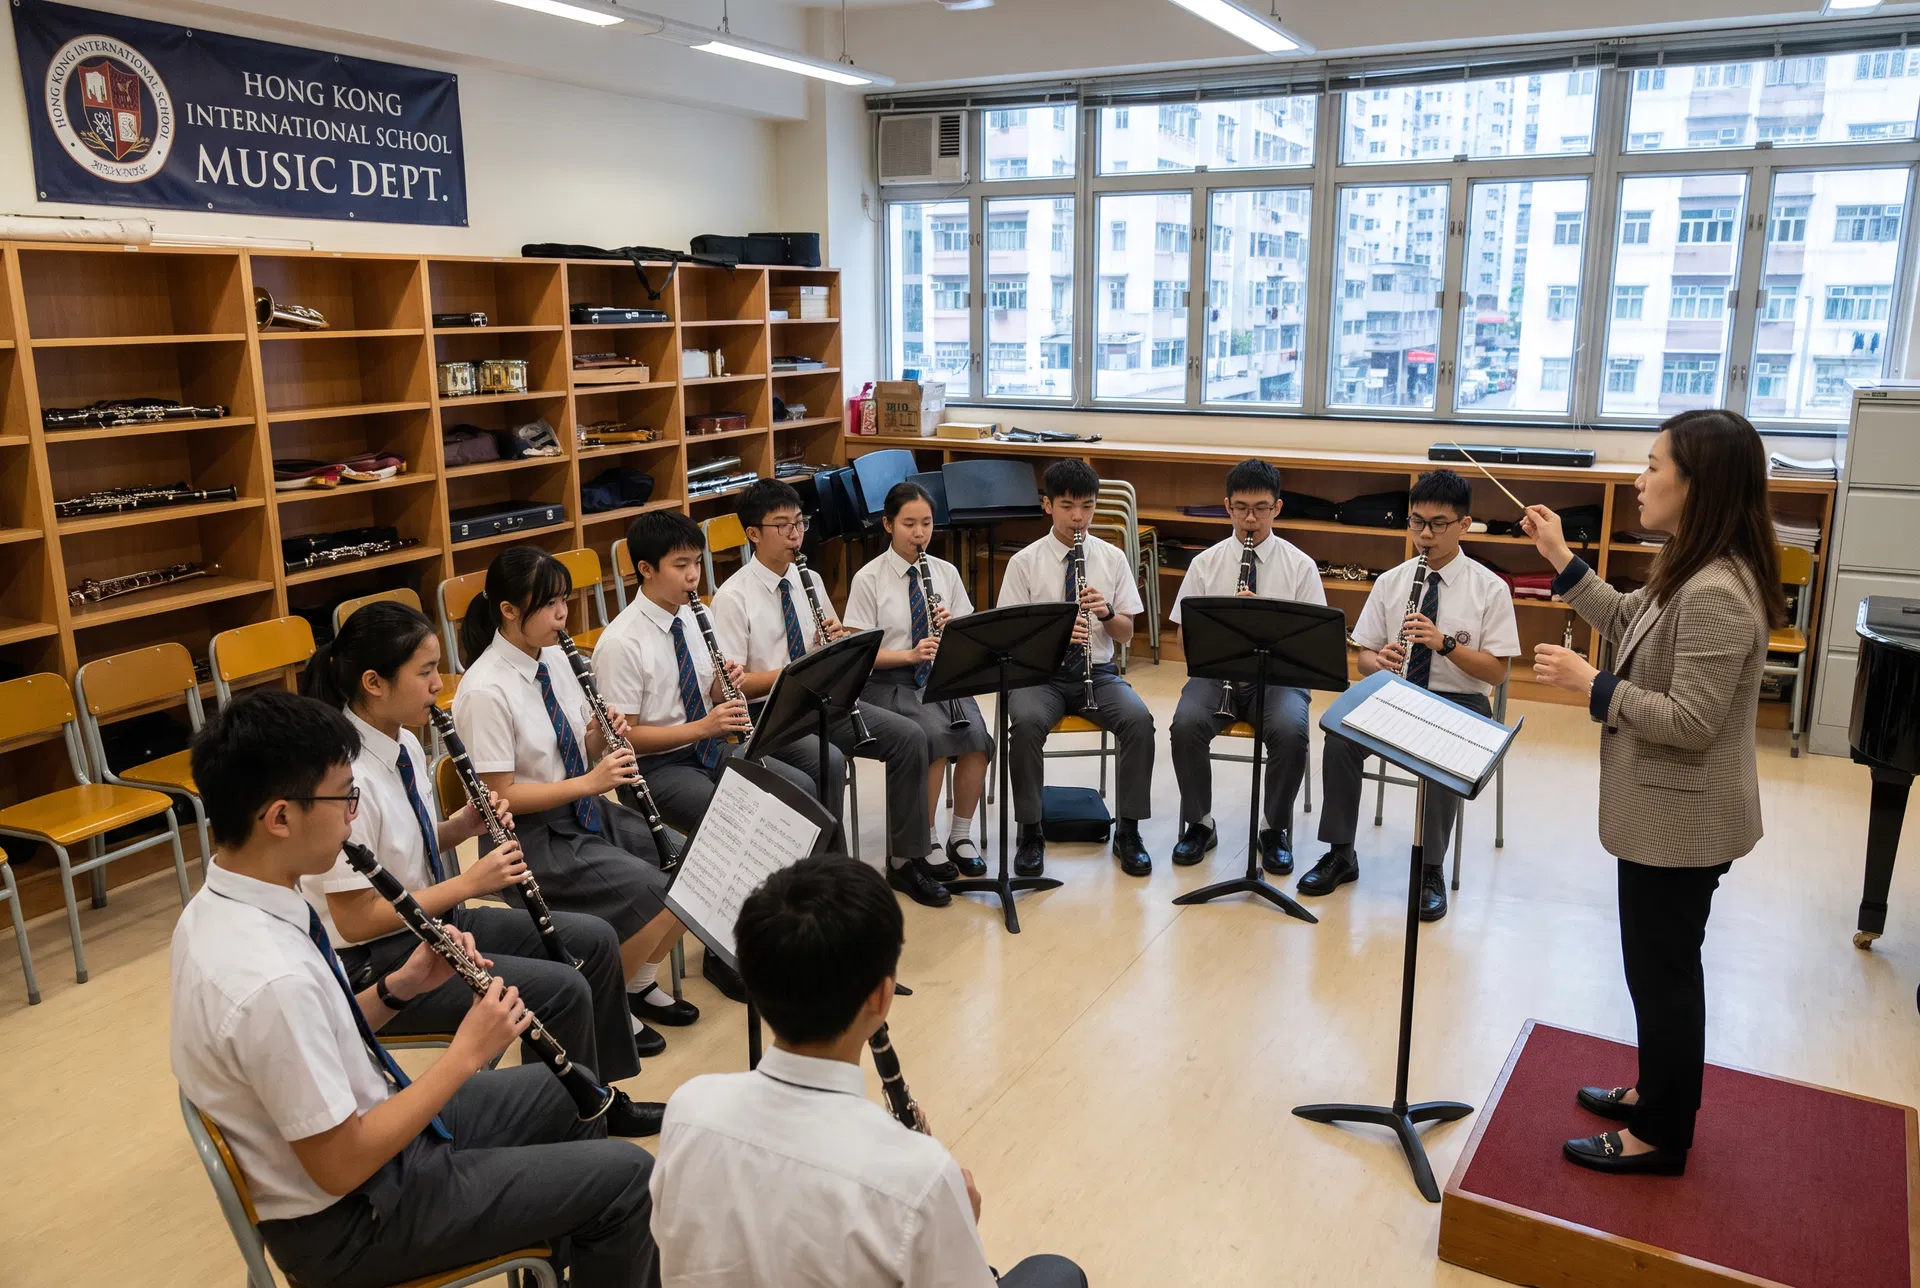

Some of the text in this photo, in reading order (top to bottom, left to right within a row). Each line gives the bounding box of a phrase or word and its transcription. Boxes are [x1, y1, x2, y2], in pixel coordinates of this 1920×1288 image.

[49, 40, 171, 140] HONG KONG INTERNATIONAL SCHOOL
[243, 71, 402, 117] HONG KONG
[186, 103, 453, 155] INTERNATIONAL SCHOOL
[195, 144, 449, 202] MUSIC DEPT.
